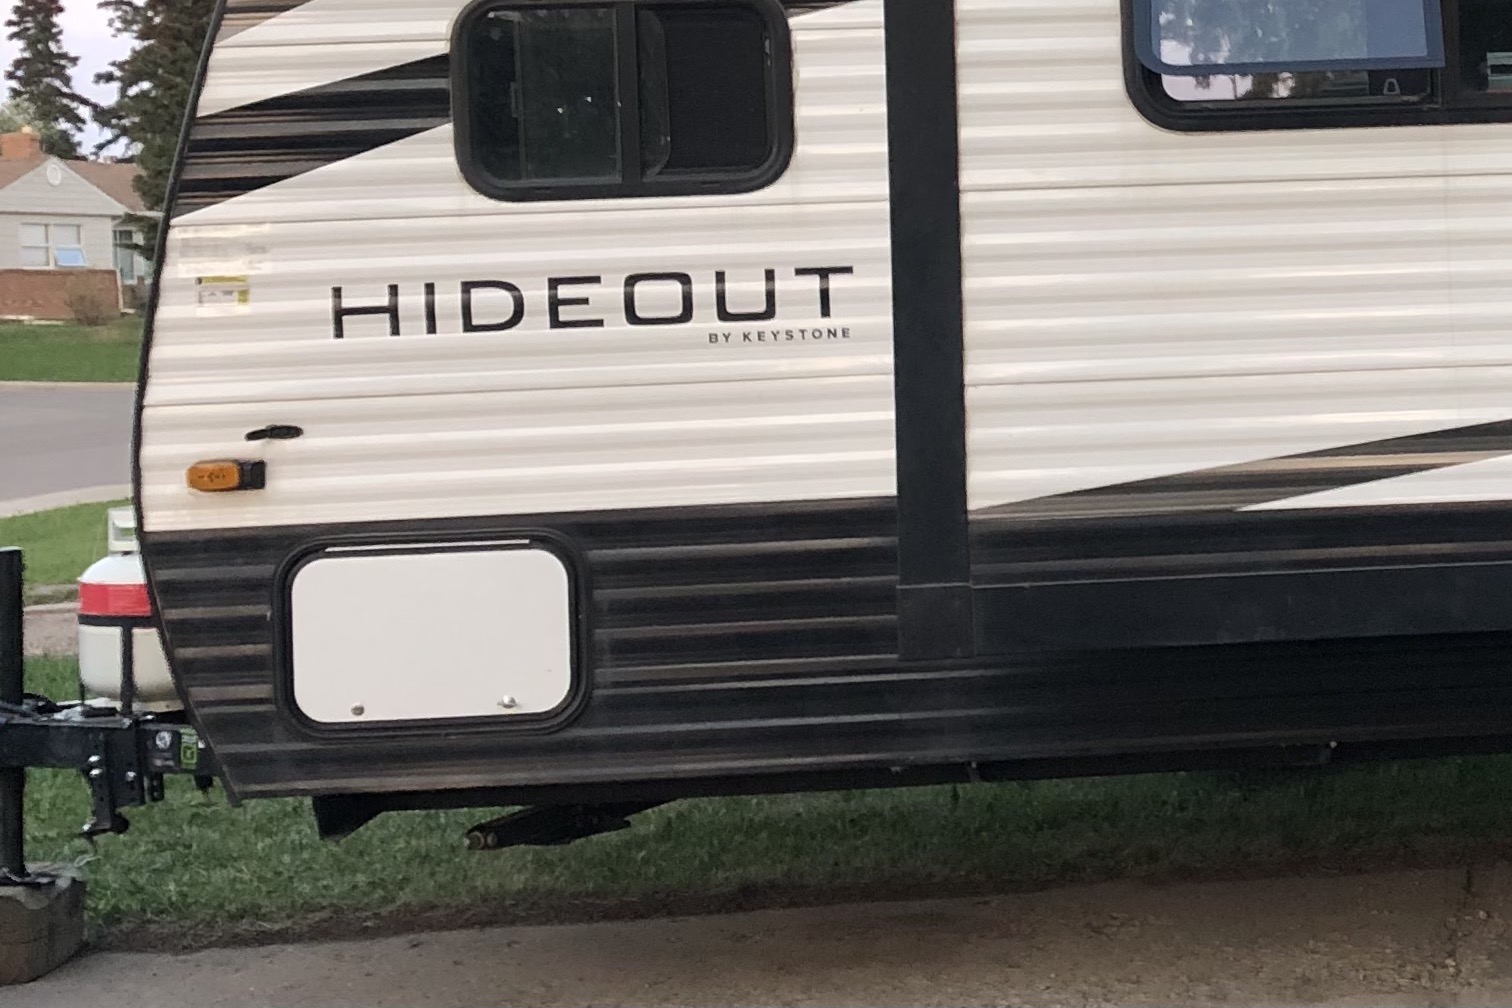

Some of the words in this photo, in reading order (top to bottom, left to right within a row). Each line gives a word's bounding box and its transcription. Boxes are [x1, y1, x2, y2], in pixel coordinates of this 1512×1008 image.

[331, 265, 854, 339] HIDEOUT
[708, 332, 732, 344] BY
[742, 327, 851, 342] KEYSTONE
